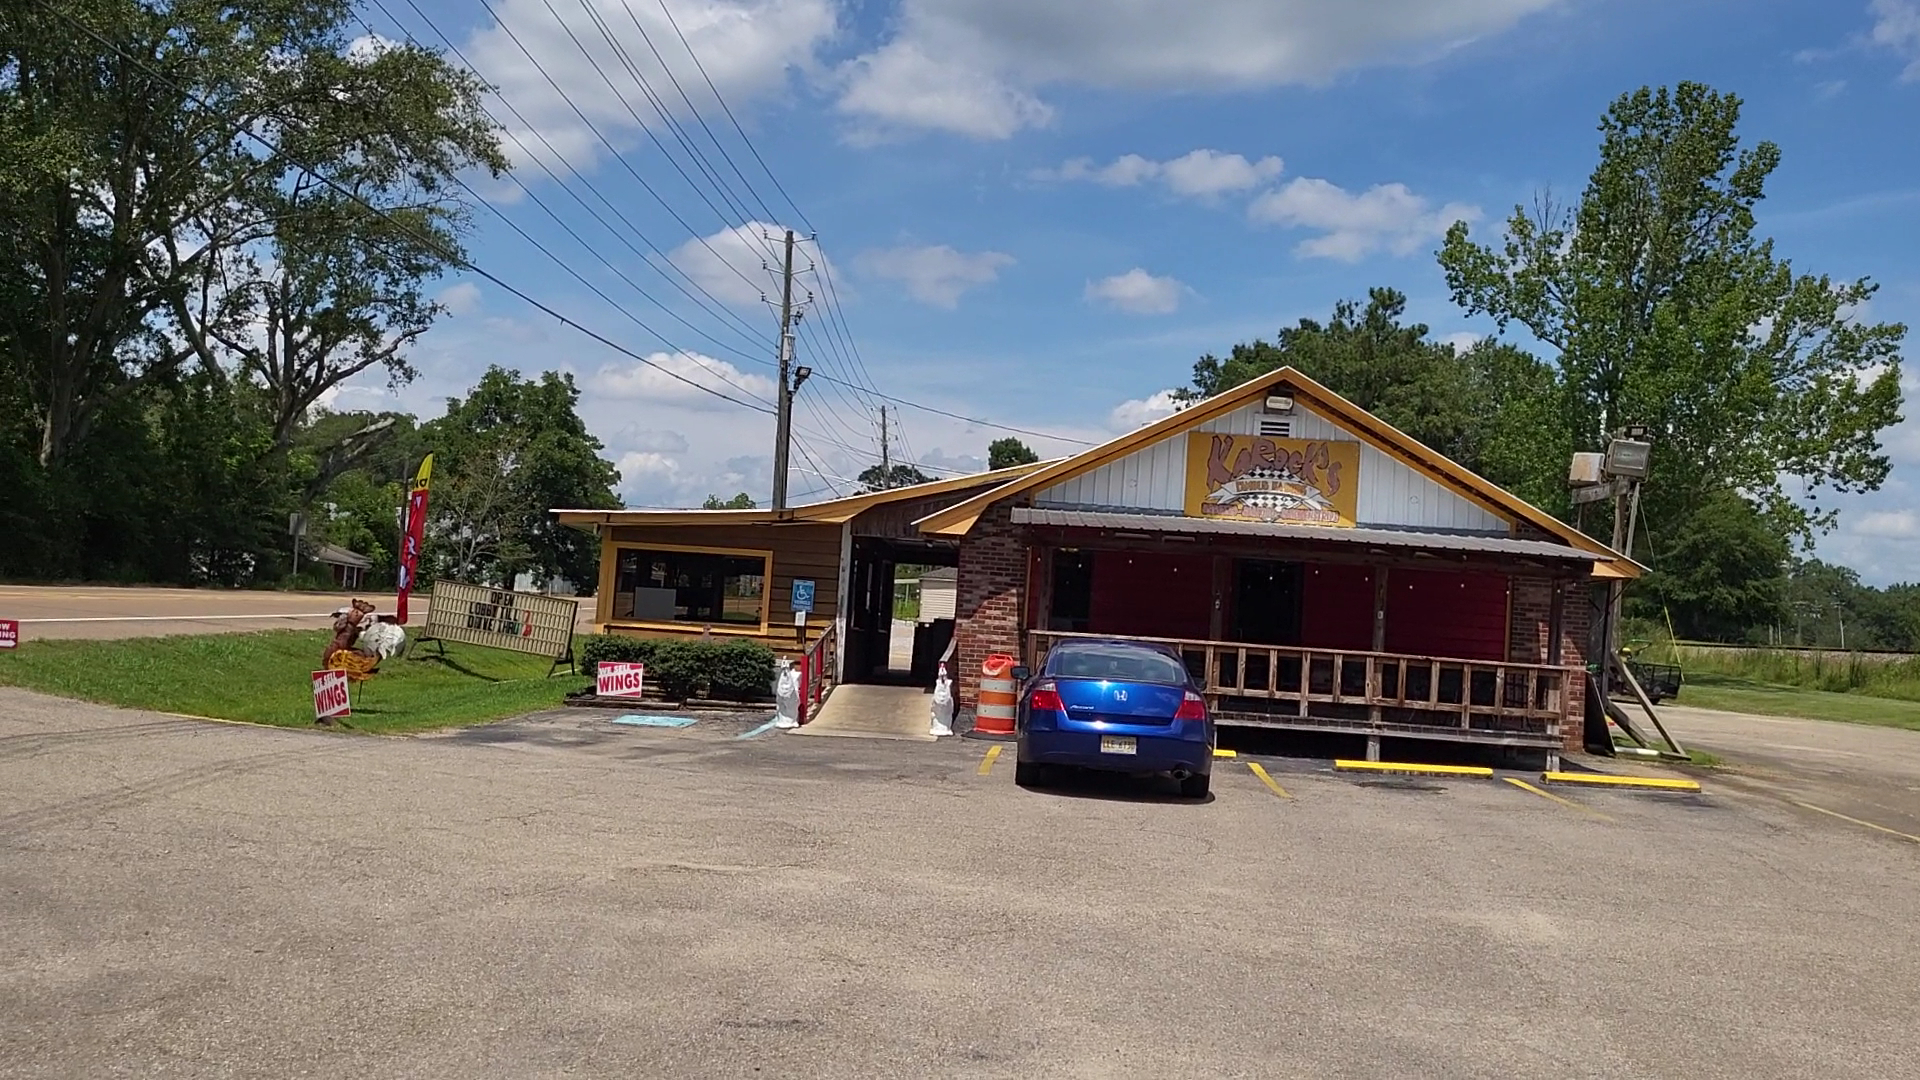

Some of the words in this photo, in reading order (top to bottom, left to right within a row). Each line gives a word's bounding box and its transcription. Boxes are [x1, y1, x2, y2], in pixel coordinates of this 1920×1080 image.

[490, 592, 515, 606] OPEN
[469, 602, 498, 618] LOBBY
[598, 672, 640, 693] WINGS
[315, 681, 347, 715] WINGS
